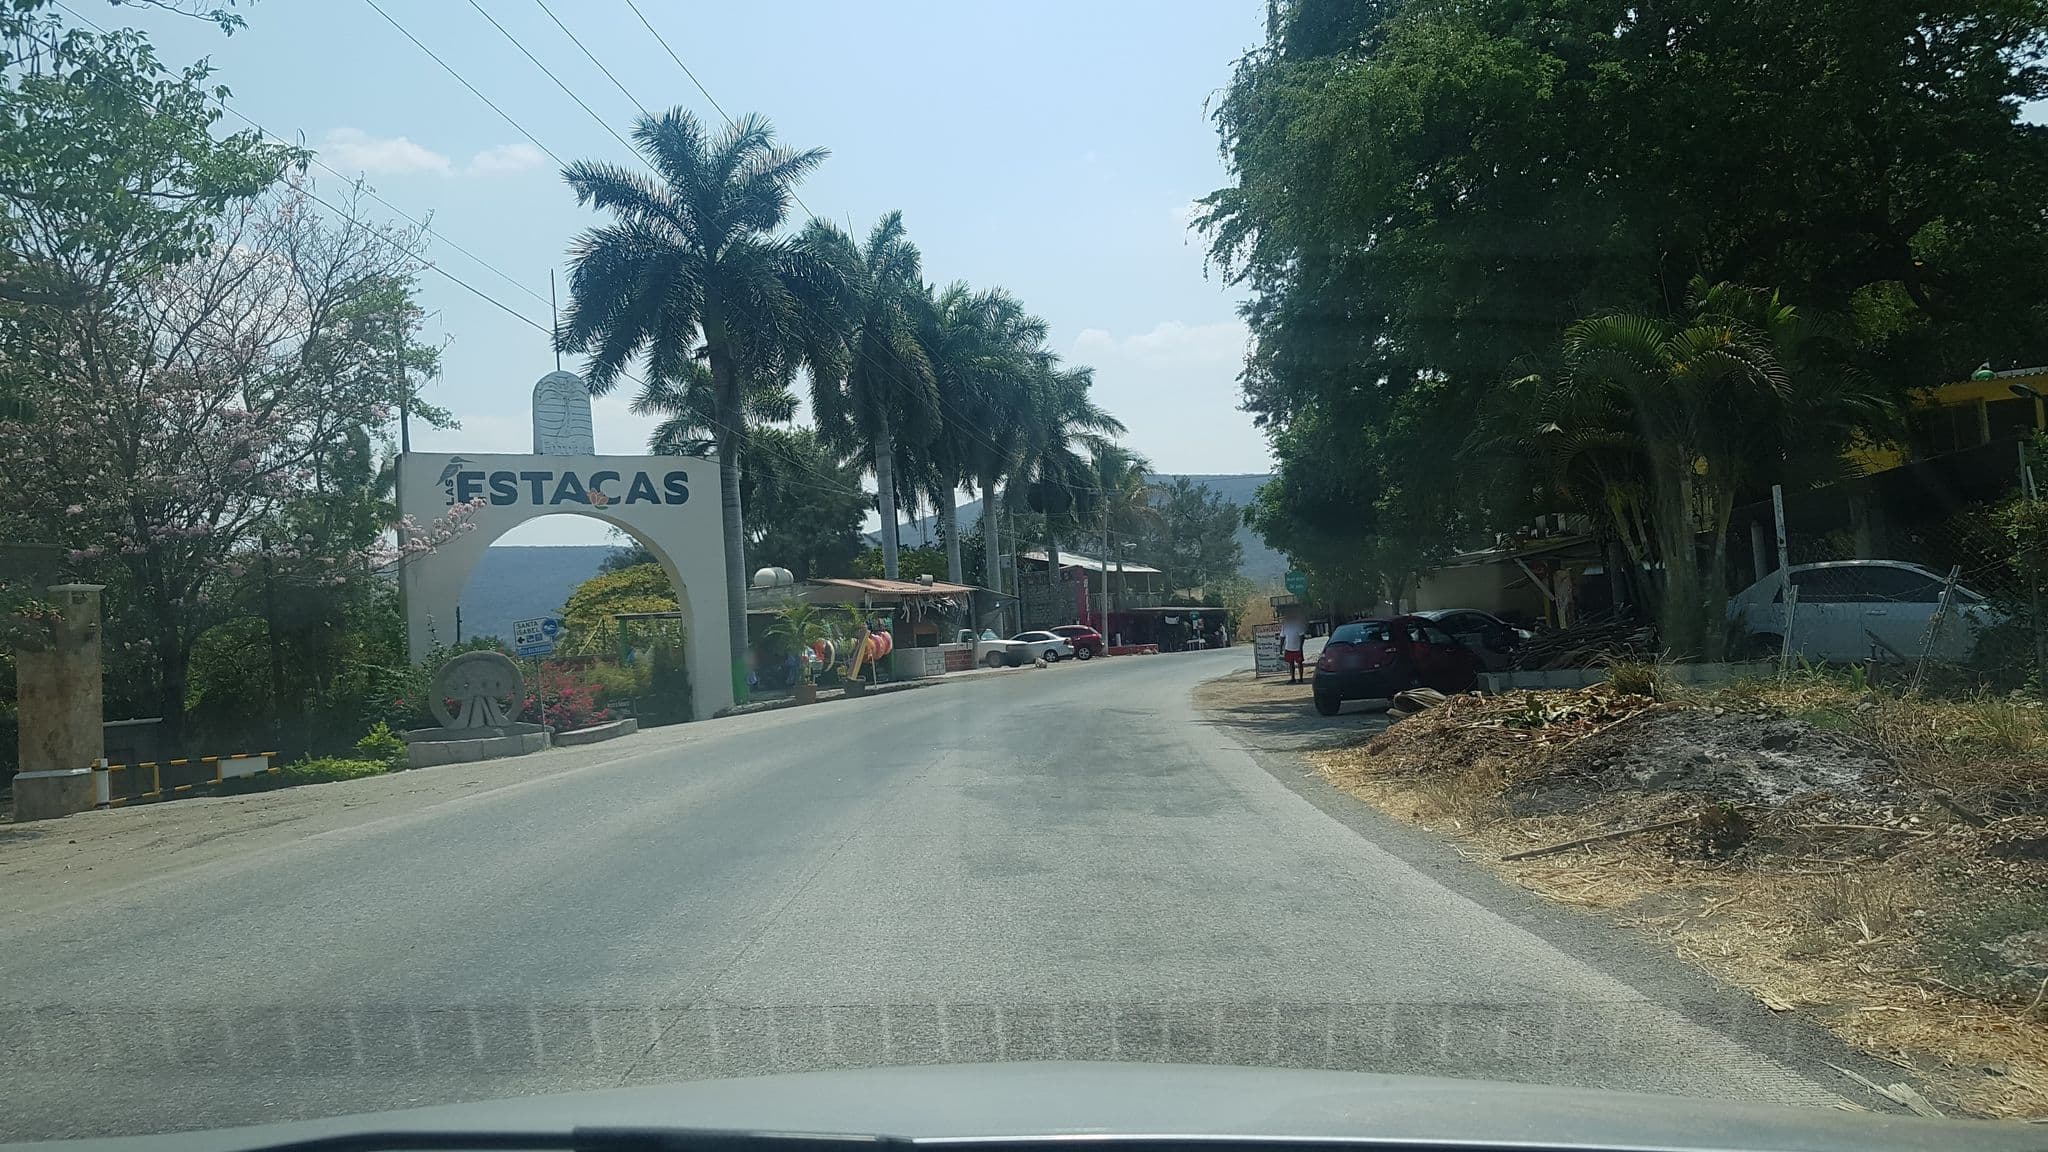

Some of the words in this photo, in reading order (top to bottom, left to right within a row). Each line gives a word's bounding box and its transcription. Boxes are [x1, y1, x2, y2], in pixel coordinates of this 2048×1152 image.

[446, 479, 454, 506] LAS
[456, 471, 690, 505] ESTACAS
[516, 621, 538, 629] SANTA
[517, 627, 540, 635] ISABEL
